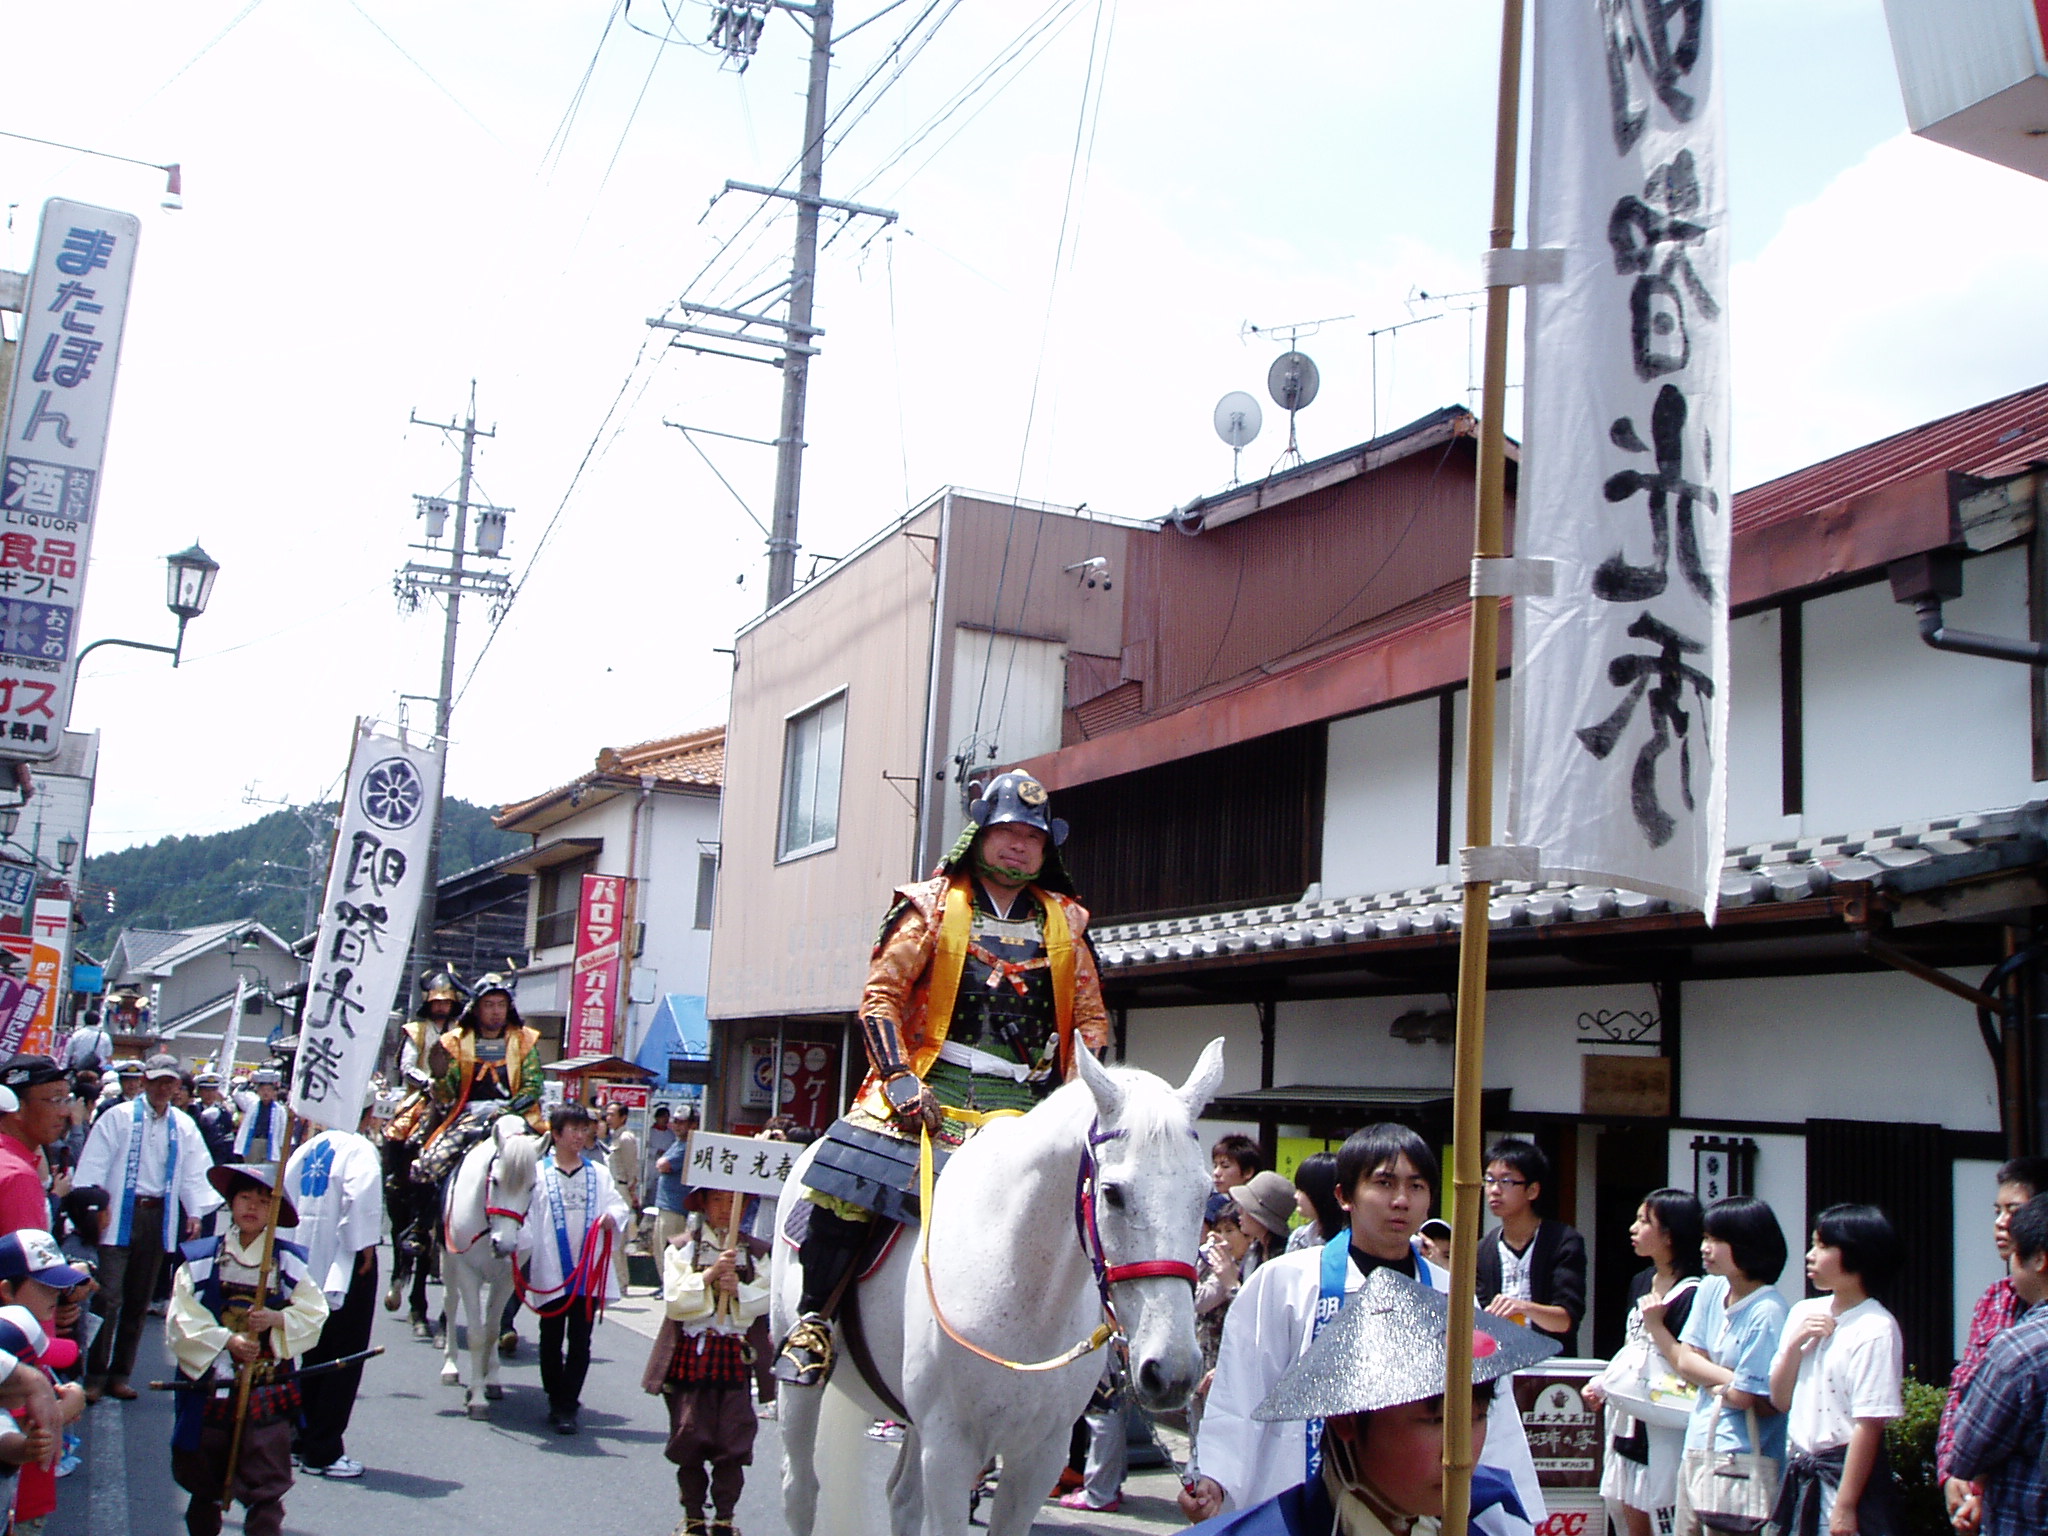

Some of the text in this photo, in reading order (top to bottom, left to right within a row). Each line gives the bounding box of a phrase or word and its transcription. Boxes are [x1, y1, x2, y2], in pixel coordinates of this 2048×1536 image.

[4, 461, 66, 514] 酒
[6, 511, 78, 534] LIQUOR
[0, 532, 77, 579] 食品
[0, 570, 69, 598] ギフト
[42, 608, 69, 657] おこめ
[586, 880, 618, 947] パロマ
